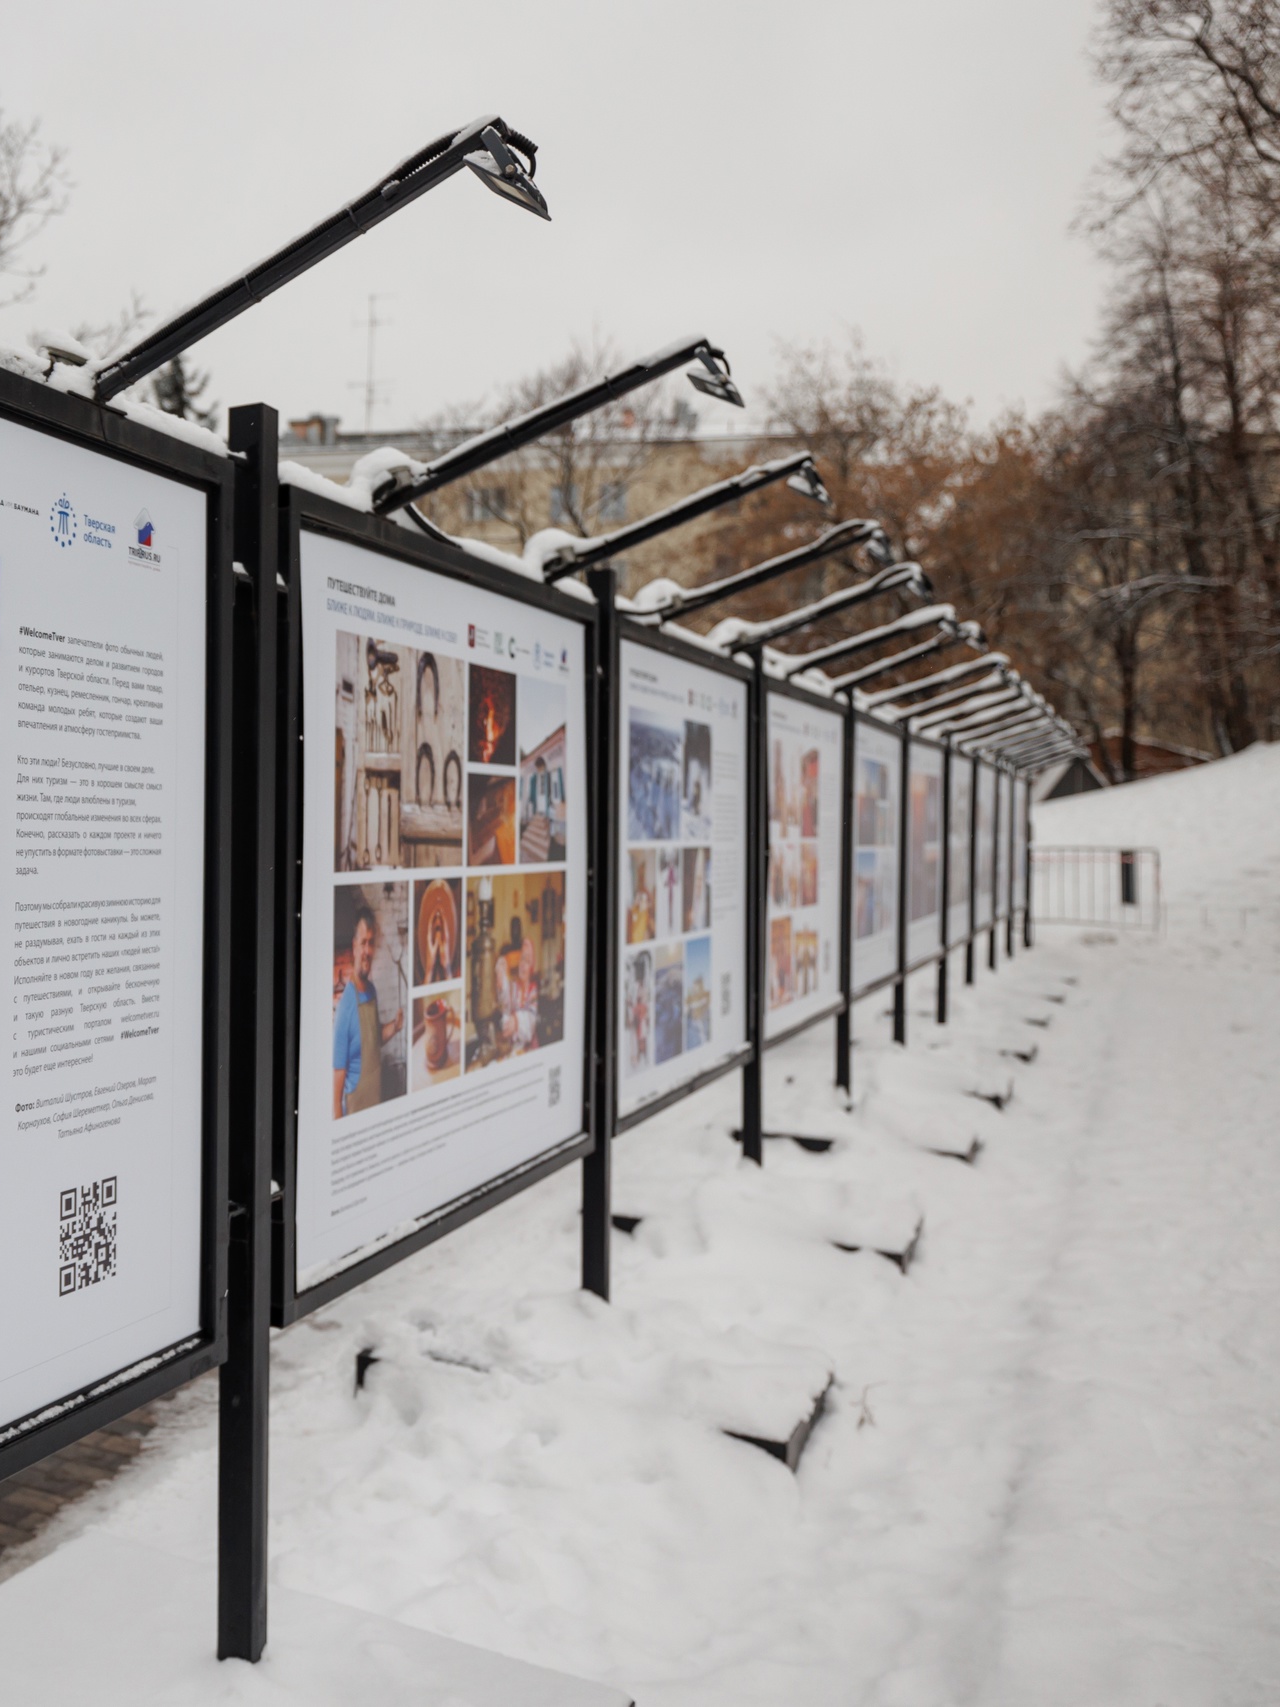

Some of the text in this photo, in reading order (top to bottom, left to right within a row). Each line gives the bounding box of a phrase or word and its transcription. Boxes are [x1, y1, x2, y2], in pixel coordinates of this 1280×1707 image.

[13, 503, 39, 516] БАУМАНА
[83, 514, 116, 534] Тверская
[83, 531, 112, 549] область
[327, 576, 396, 607] ПУТЕШЕСТВУЙТЕ ДОМА
[326, 597, 347, 616] БЛИЖЕ
[19, 626, 65, 642] #WelcomeTver
[67, 636, 103, 649] запечатлели
[104, 643, 119, 652] фото
[18, 646, 46, 657] которые
[48, 650, 83, 663] занимаются
[85, 657, 104, 666] делом
[25, 665, 54, 677] курортов
[56, 667, 84, 680] Тверской
[86, 673, 109, 685] области.
[17, 682, 45, 694] отельер,
[47, 687, 69, 698] кузнец,
[70, 690, 110, 703] ремесленник,
[17, 701, 45, 712] команда
[48, 705, 75, 715] молодых
[78, 707, 95, 718] ребят,
[98, 711, 122, 721] которые
[17, 719, 57, 730] впечатления
[63, 724, 95, 737] атмосферу
[17, 754, 28, 765] Кто
[29, 757, 40, 765] эти
[40, 757, 60, 767] люди?
[61, 757, 96, 770] Безусловно,
[97, 762, 119, 772] лучшие
[16, 772, 29, 784] Для
[45, 776, 68, 786] туризм
[96, 780, 122, 788] хорошем
[16, 793, 38, 801] жизни.
[39, 792, 52, 803] Там,
[53, 795, 63, 803] где
[64, 795, 80, 804] люди
[81, 794, 110, 805] влюблены
[16, 811, 53, 821] происходят
[54, 810, 89, 821] глобальные
[90, 814, 121, 822] изменения
[15, 828, 44, 838] Конечно,
[47, 830, 80, 840] рассказать
[89, 831, 111, 839] каждом
[15, 848, 24, 856] не
[24, 848, 52, 859] упустить
[56, 847, 83, 857] формате
[82, 847, 123, 857] фотовыставки
[15, 867, 38, 876] задача.
[14, 901, 42, 912] Поэтому
[51, 899, 77, 911] собрали
[77, 900, 105, 910] красивую
[14, 920, 55, 932] путешествия
[63, 917, 99, 926] новогодние
[14, 940, 22, 948] не
[25, 937, 64, 948] раздумывая,
[66, 936, 83, 944] ехать
[91, 934, 106, 942] гости
[13, 950, 119, 967] объектов лично встретить наших
[13, 972, 52, 985] Исполняйте
[59, 971, 79, 980] новом
[80, 969, 93, 979] году
[94, 968, 104, 976] все
[23, 989, 72, 1004] путешествиями,
[87, 983, 120, 994] открывайте
[25, 1010, 44, 1021] такую
[50, 1006, 73, 1018] разную
[79, 1001, 107, 1012] Тверскую
[27, 1024, 74, 1040] туристическим
[83, 1018, 111, 1029] порталом
[20, 1046, 47, 1056] нашими
[49, 1038, 91, 1052] социальными
[94, 1035, 114, 1044] сетями
[24, 1064, 42, 1076] будет
[43, 1062, 56, 1071] еще
[57, 1053, 93, 1068] интереснее!
[14, 1102, 35, 1113] Фото:
[35, 1093, 64, 1108] Виталий
[64, 1089, 93, 1103] Шустров,
[94, 1082, 115, 1096] Евгений
[52, 1111, 72, 1122] София
[57, 1126, 83, 1138] Татьяна
